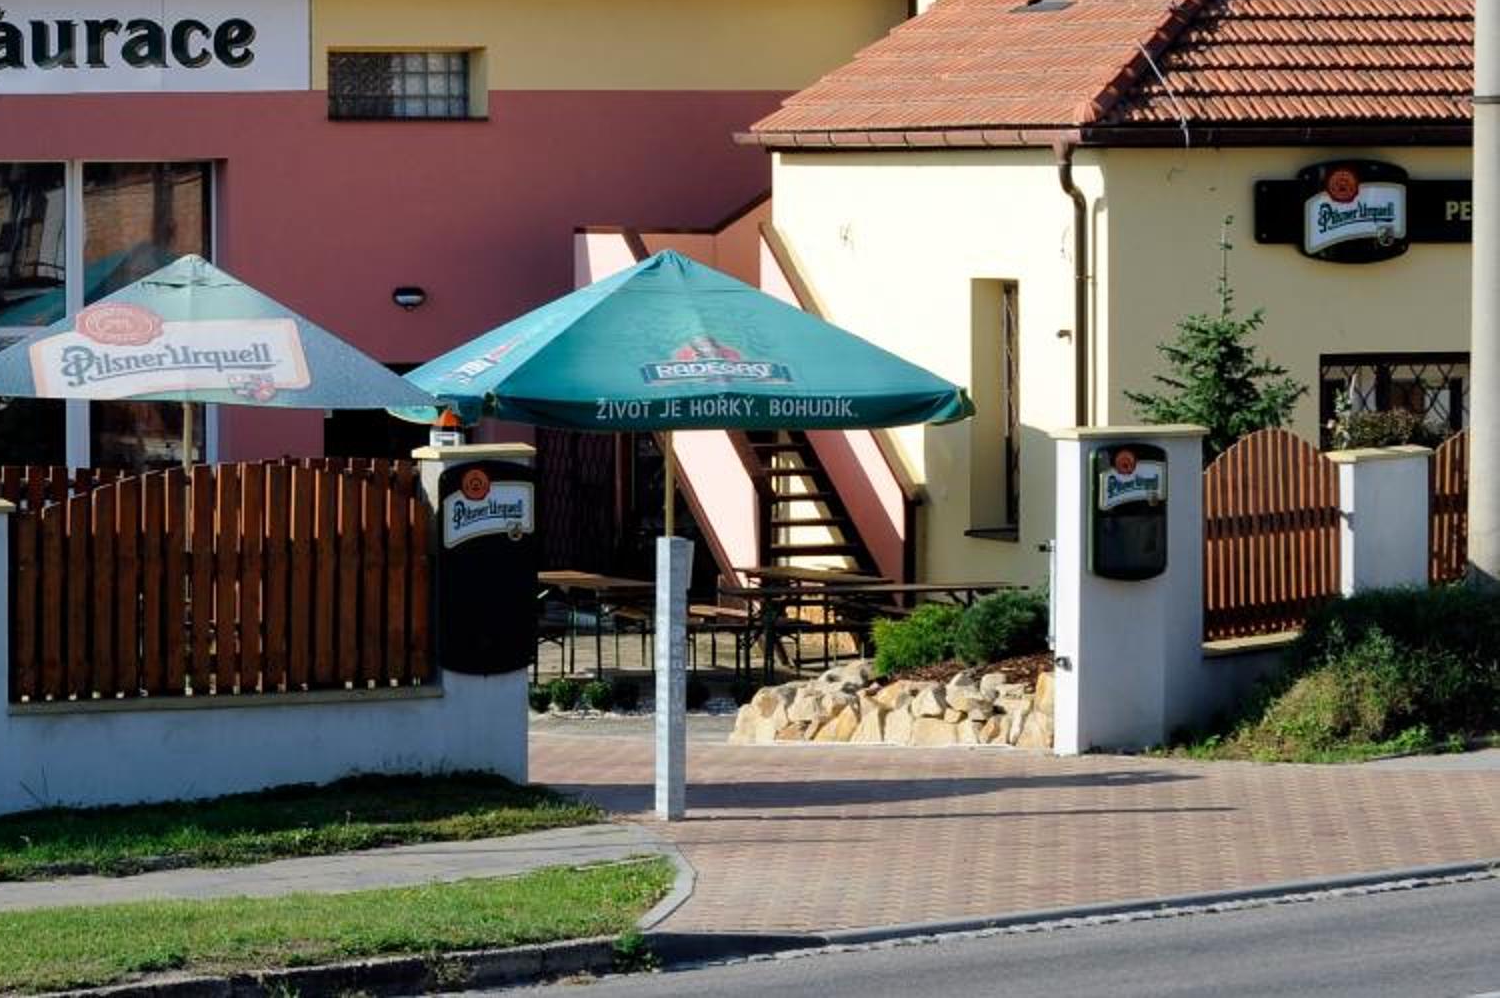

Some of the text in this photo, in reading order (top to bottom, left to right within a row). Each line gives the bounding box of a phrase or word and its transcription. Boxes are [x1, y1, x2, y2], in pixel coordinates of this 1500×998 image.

[1445, 201, 1472, 221] PE
[61, 343, 272, 388] Pilsner Urquell
[595, 397, 651, 419] ŽIVOT
[659, 399, 683, 418] JE
